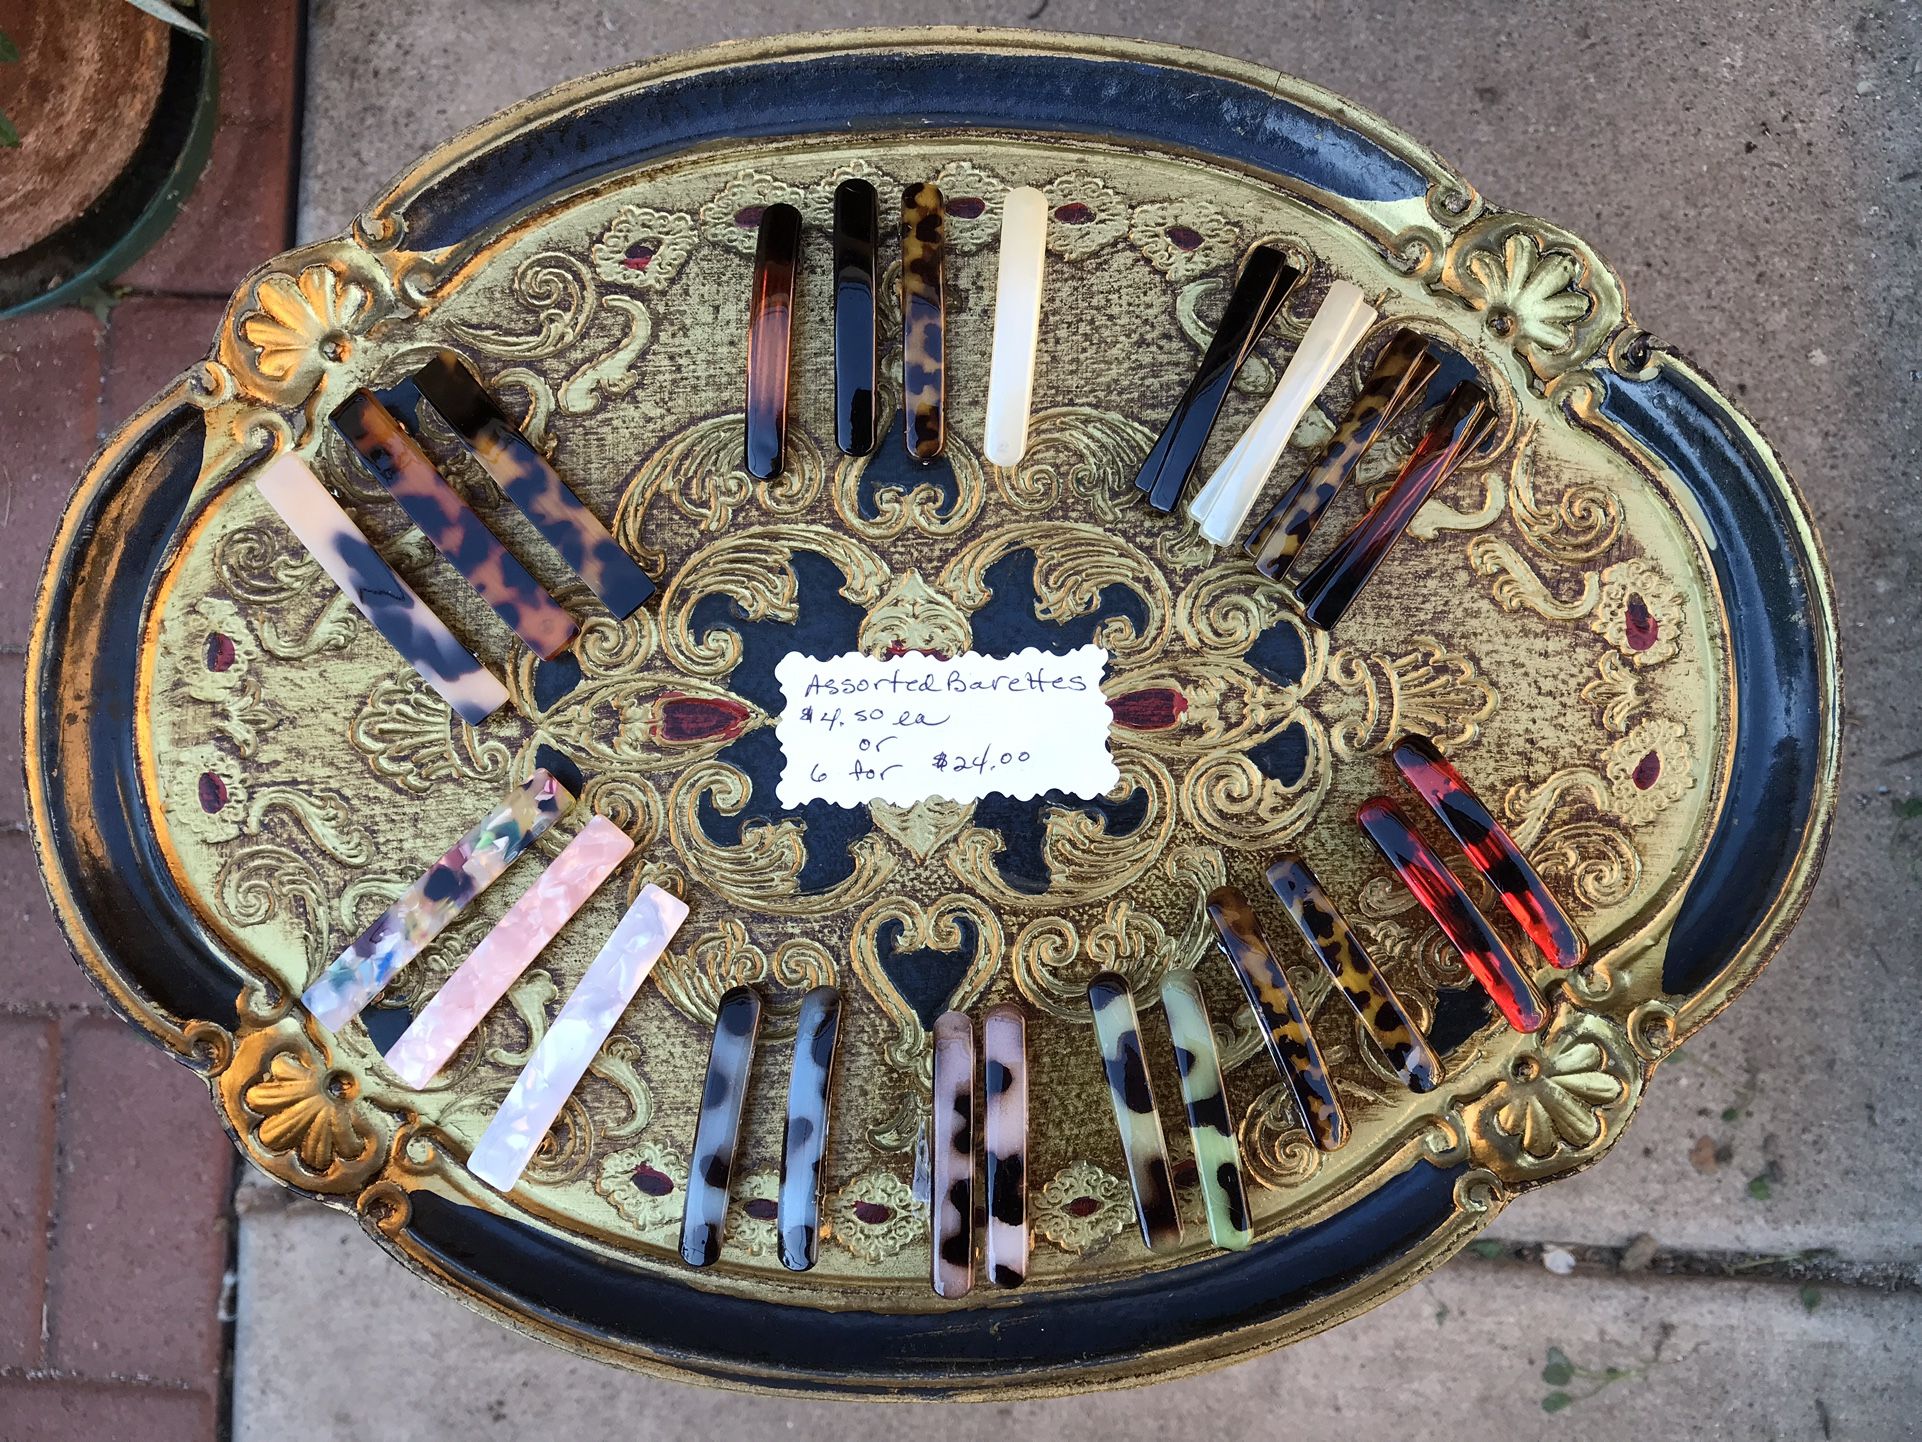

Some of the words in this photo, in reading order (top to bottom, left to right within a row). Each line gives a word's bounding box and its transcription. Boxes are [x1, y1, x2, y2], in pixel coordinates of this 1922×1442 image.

[805, 669, 942, 697] Assorted
[947, 668, 1087, 692] Barettes
[892, 710, 950, 726] ea
[859, 736, 897, 752] or
[810, 763, 827, 782] 6
[849, 759, 903, 781] for
[932, 743, 1030, 774] $24.00
